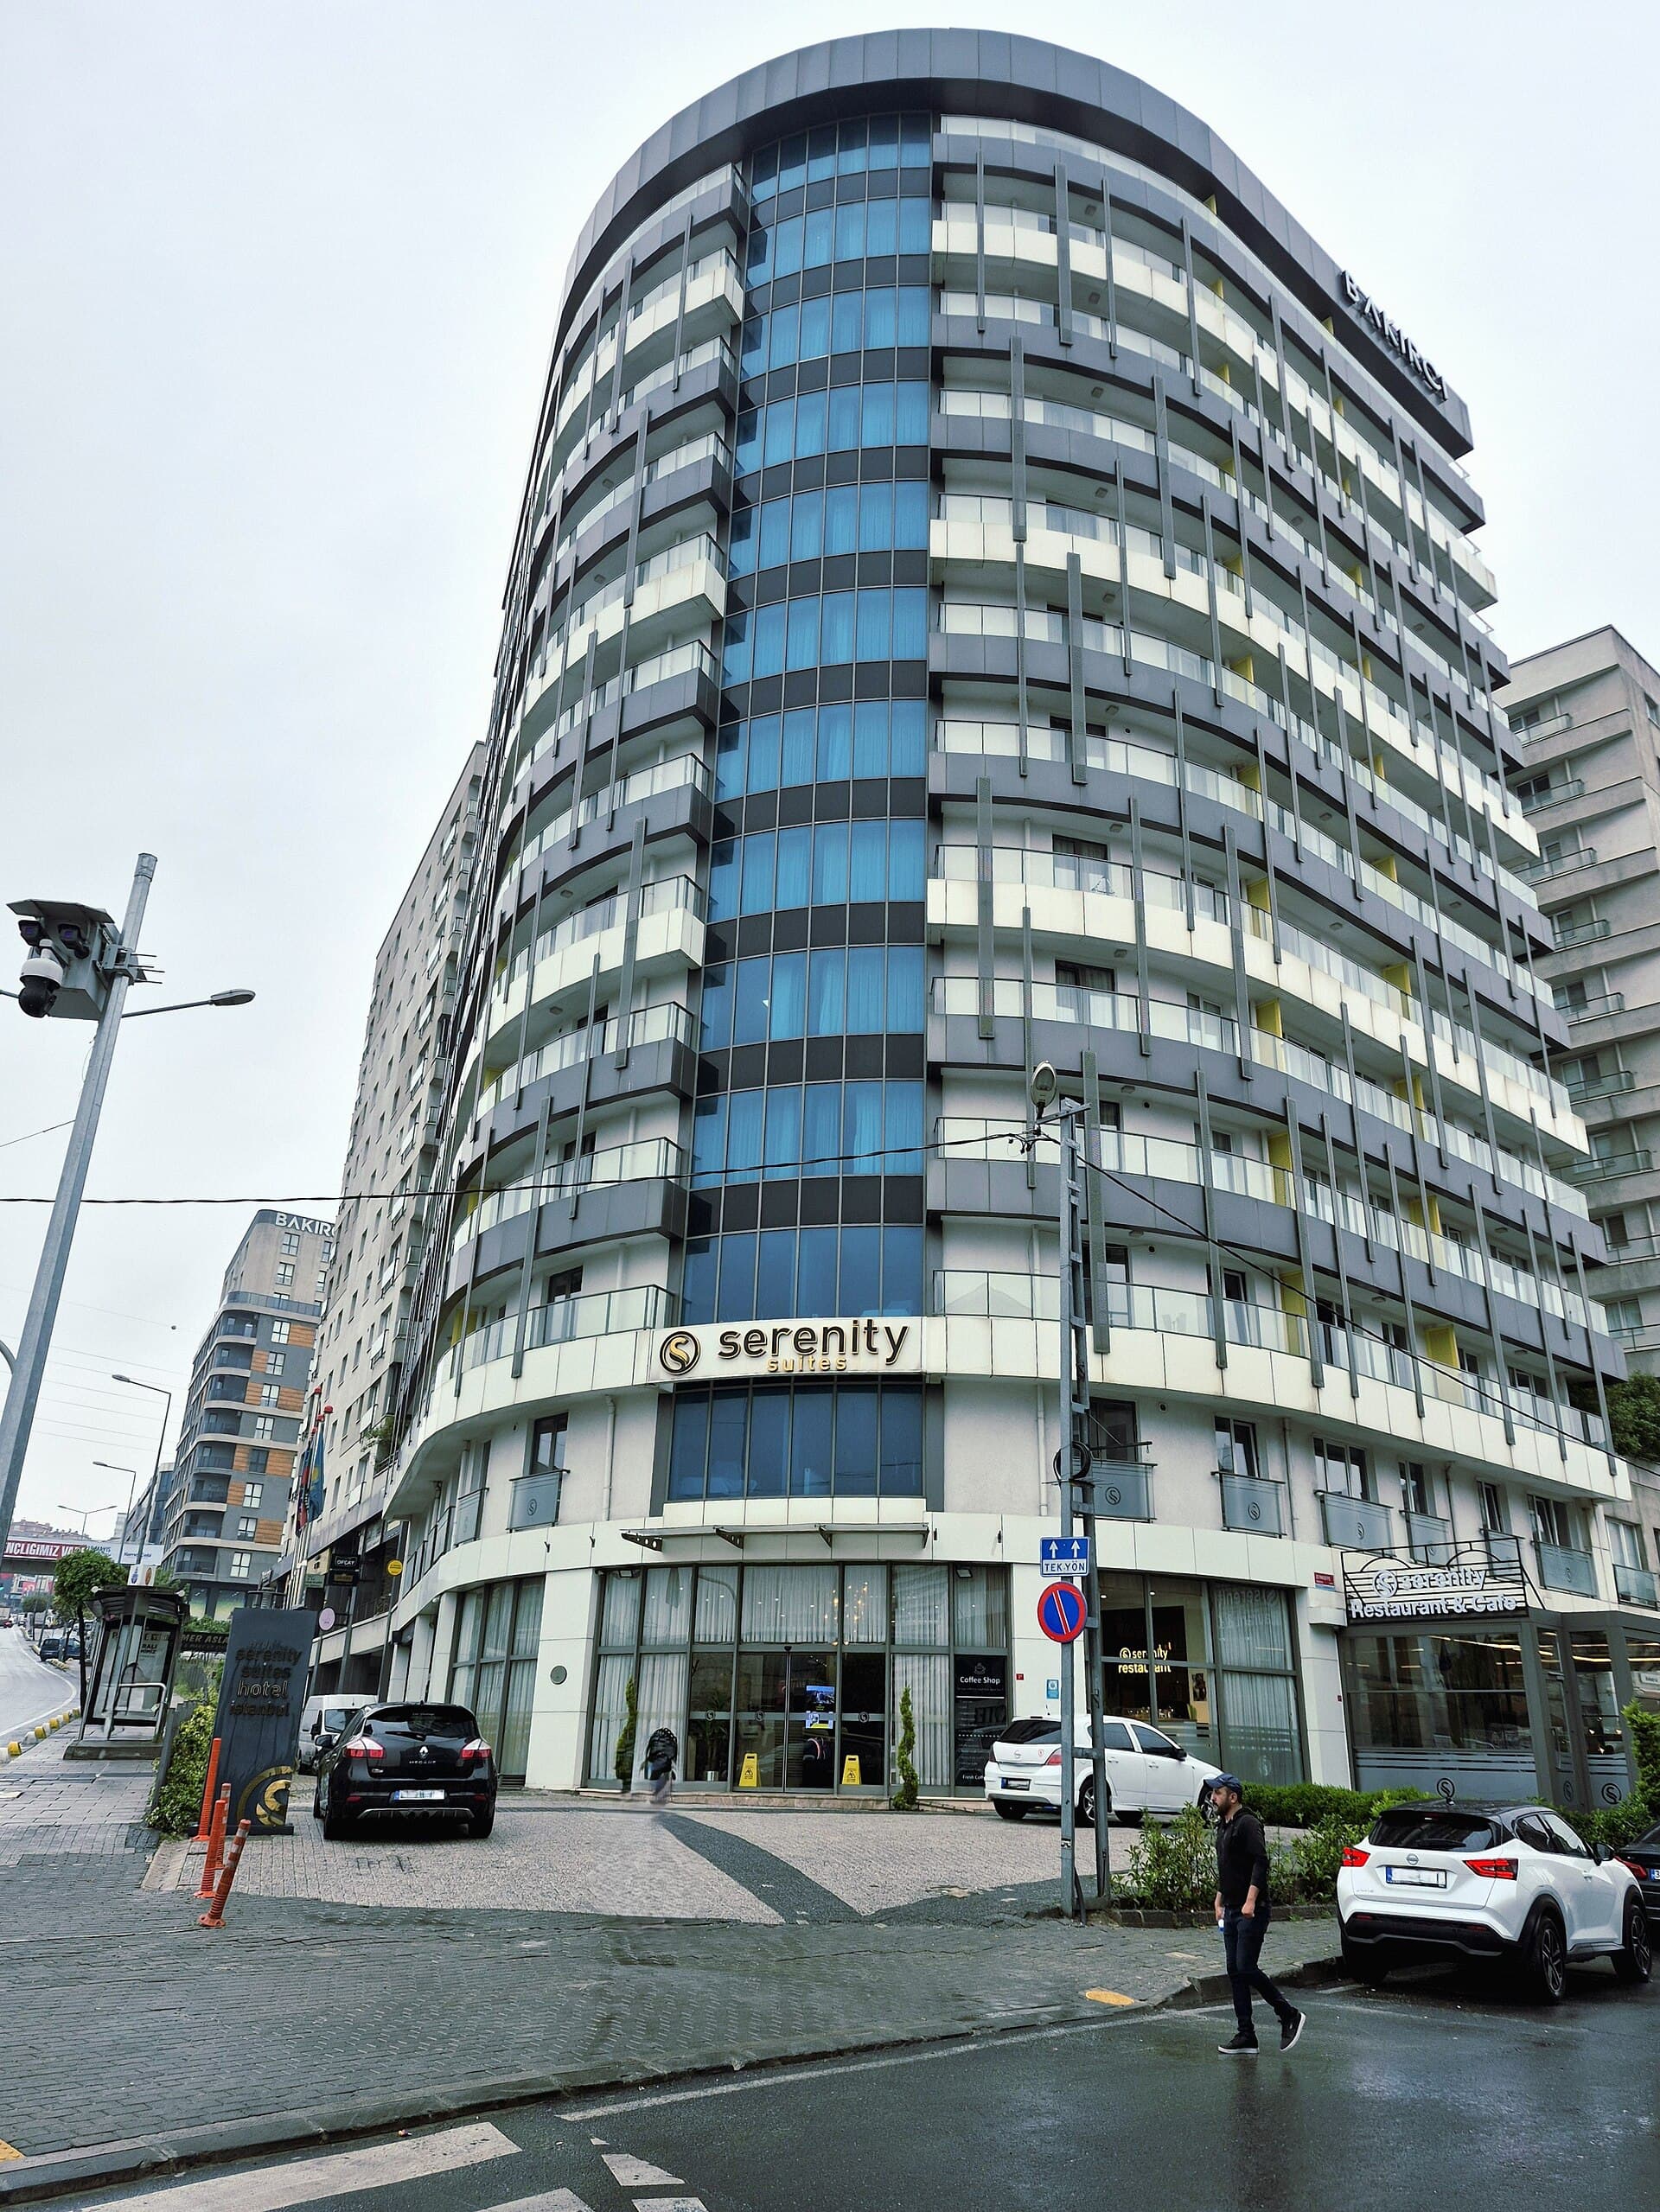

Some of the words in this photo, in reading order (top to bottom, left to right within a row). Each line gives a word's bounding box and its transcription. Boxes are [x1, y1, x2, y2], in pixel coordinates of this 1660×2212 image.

[718, 1319, 909, 1365] serenity
[767, 1355, 847, 1373] suites
[1044, 1563, 1063, 1572] TEK
[1064, 1559, 1085, 1571] YÖN
[1400, 1567, 1487, 1591] serenity
[1350, 1597, 1449, 1619] Restaurant
[1454, 1596, 1468, 1614] &
[180, 1634, 203, 1642] MER
[204, 1635, 228, 1644] ASLA
[1133, 1645, 1168, 1661] sernity
[1118, 1663, 1172, 1674] restauant
[237, 1680, 289, 1698] hotel
[983, 1676, 1001, 1686] Shop
